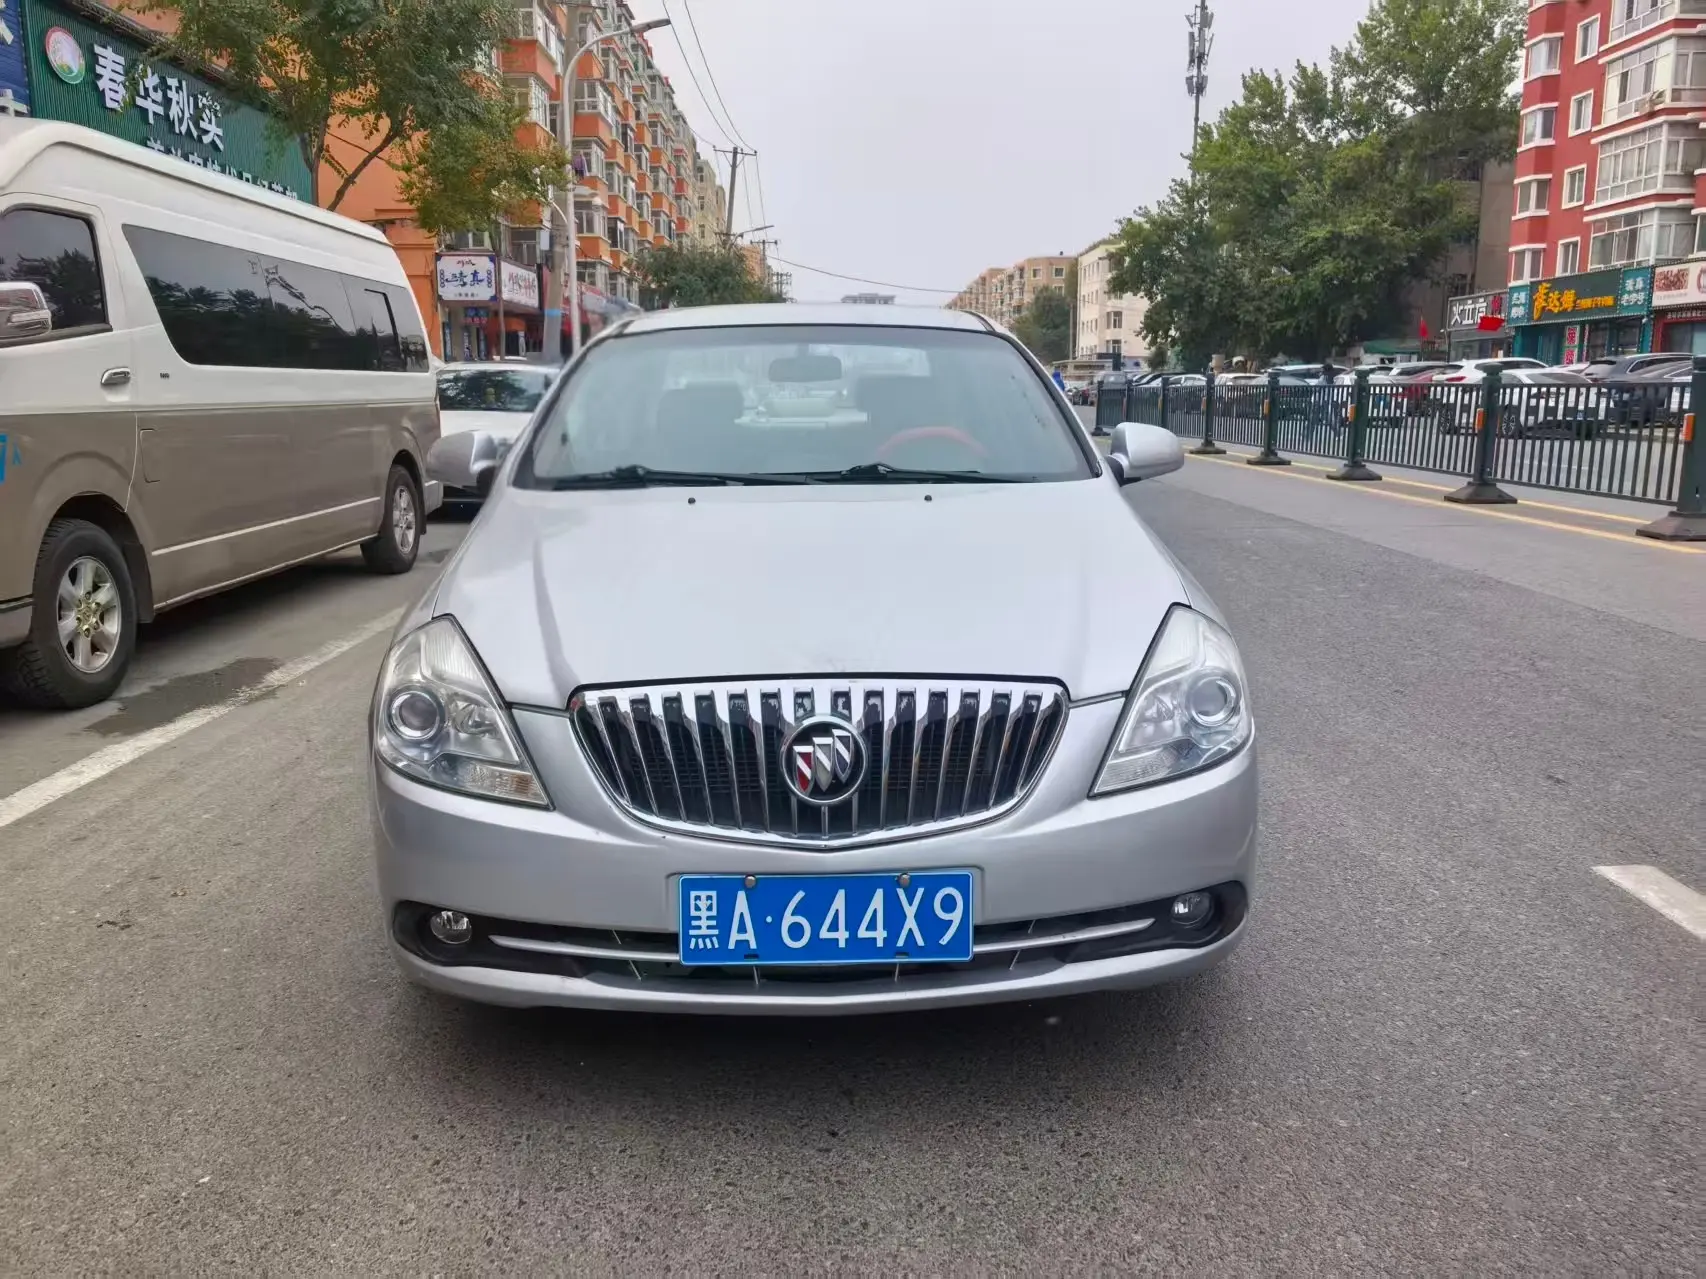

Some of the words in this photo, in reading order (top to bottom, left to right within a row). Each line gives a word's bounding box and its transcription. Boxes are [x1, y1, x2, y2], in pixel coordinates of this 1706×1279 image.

[94, 43, 224, 151] 春华秋实
[689, 886, 964, 950] 黑A·644X9
